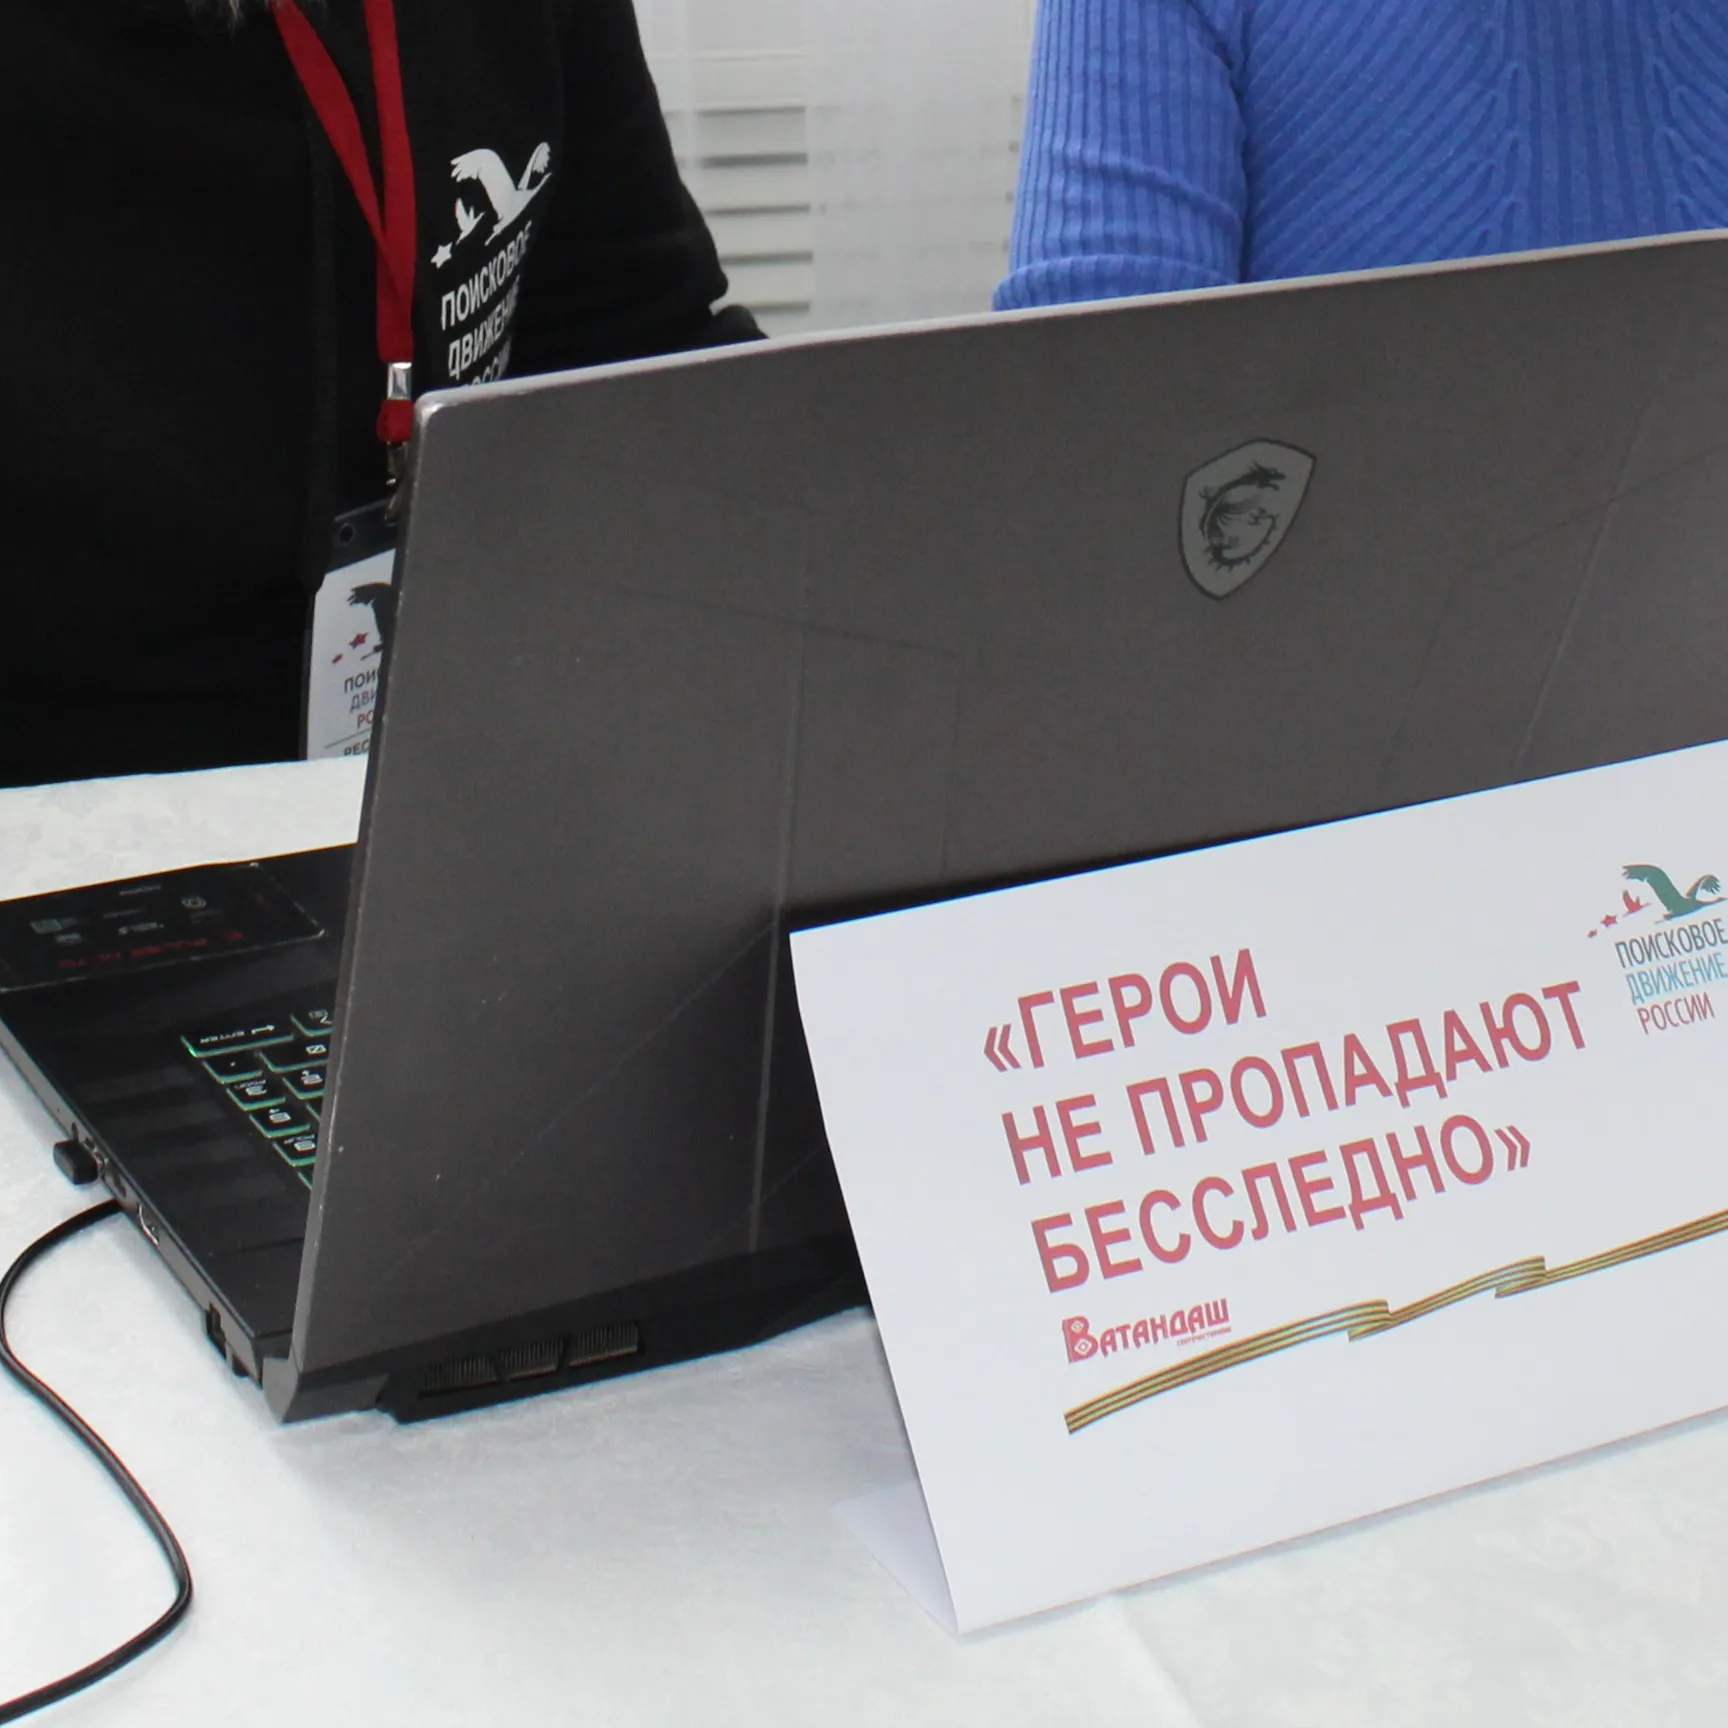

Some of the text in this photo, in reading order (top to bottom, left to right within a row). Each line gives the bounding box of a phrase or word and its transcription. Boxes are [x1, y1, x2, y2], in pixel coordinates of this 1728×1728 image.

[983, 948, 1267, 1073] «ГЕРОИ
[1001, 980, 1586, 1186] НЕ ПРОПАДАЮТ
[1636, 991, 1716, 1036] РОССИИ
[1031, 1114, 1532, 1294] БЕССЛЕДНО»
